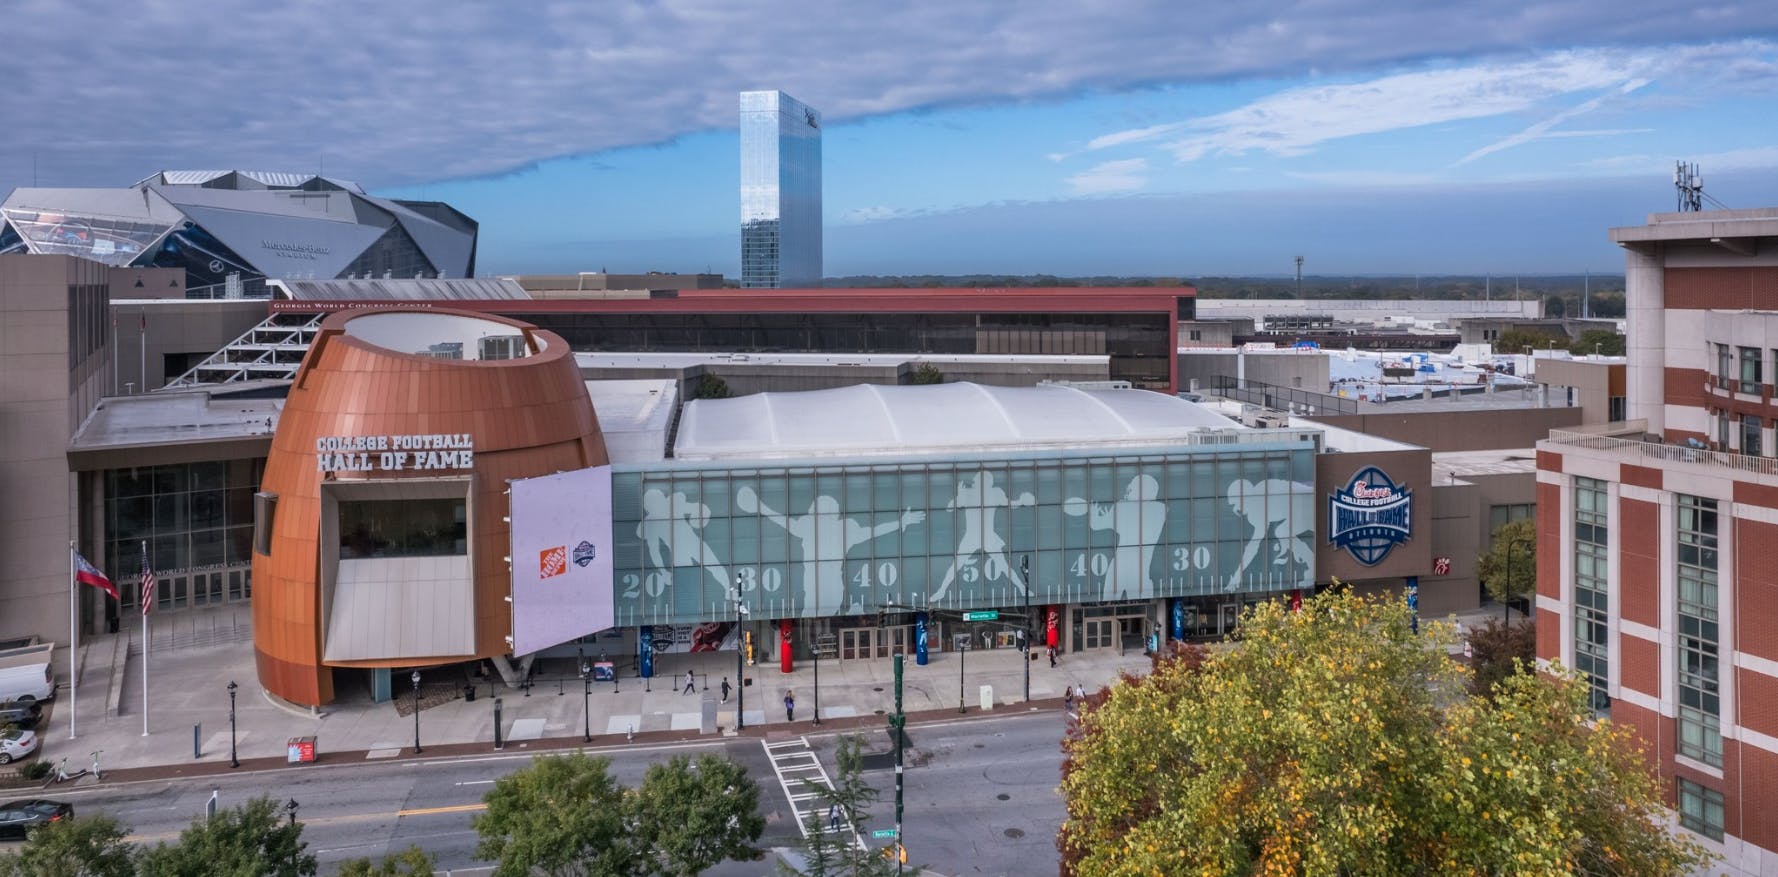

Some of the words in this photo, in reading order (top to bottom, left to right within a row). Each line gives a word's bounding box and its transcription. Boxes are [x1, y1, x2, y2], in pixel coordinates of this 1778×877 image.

[261, 239, 330, 255] Mercedes-Benz
[317, 436, 388, 451] COLLEGE
[392, 434, 473, 450] FOOTBALL
[317, 452, 373, 472] HALL
[381, 451, 407, 471] OF
[414, 451, 473, 470] FAME
[1341, 494, 1370, 506] COLLEGE
[1370, 492, 1403, 506] FOOTBALL
[1338, 505, 1369, 531] HALL
[1377, 503, 1408, 529] FAME
[622, 572, 666, 598] 20
[738, 567, 781, 592] 30
[853, 562, 897, 587] 40
[962, 558, 1002, 583] 50
[1070, 553, 1109, 577] 40
[1173, 546, 1211, 571] 30
